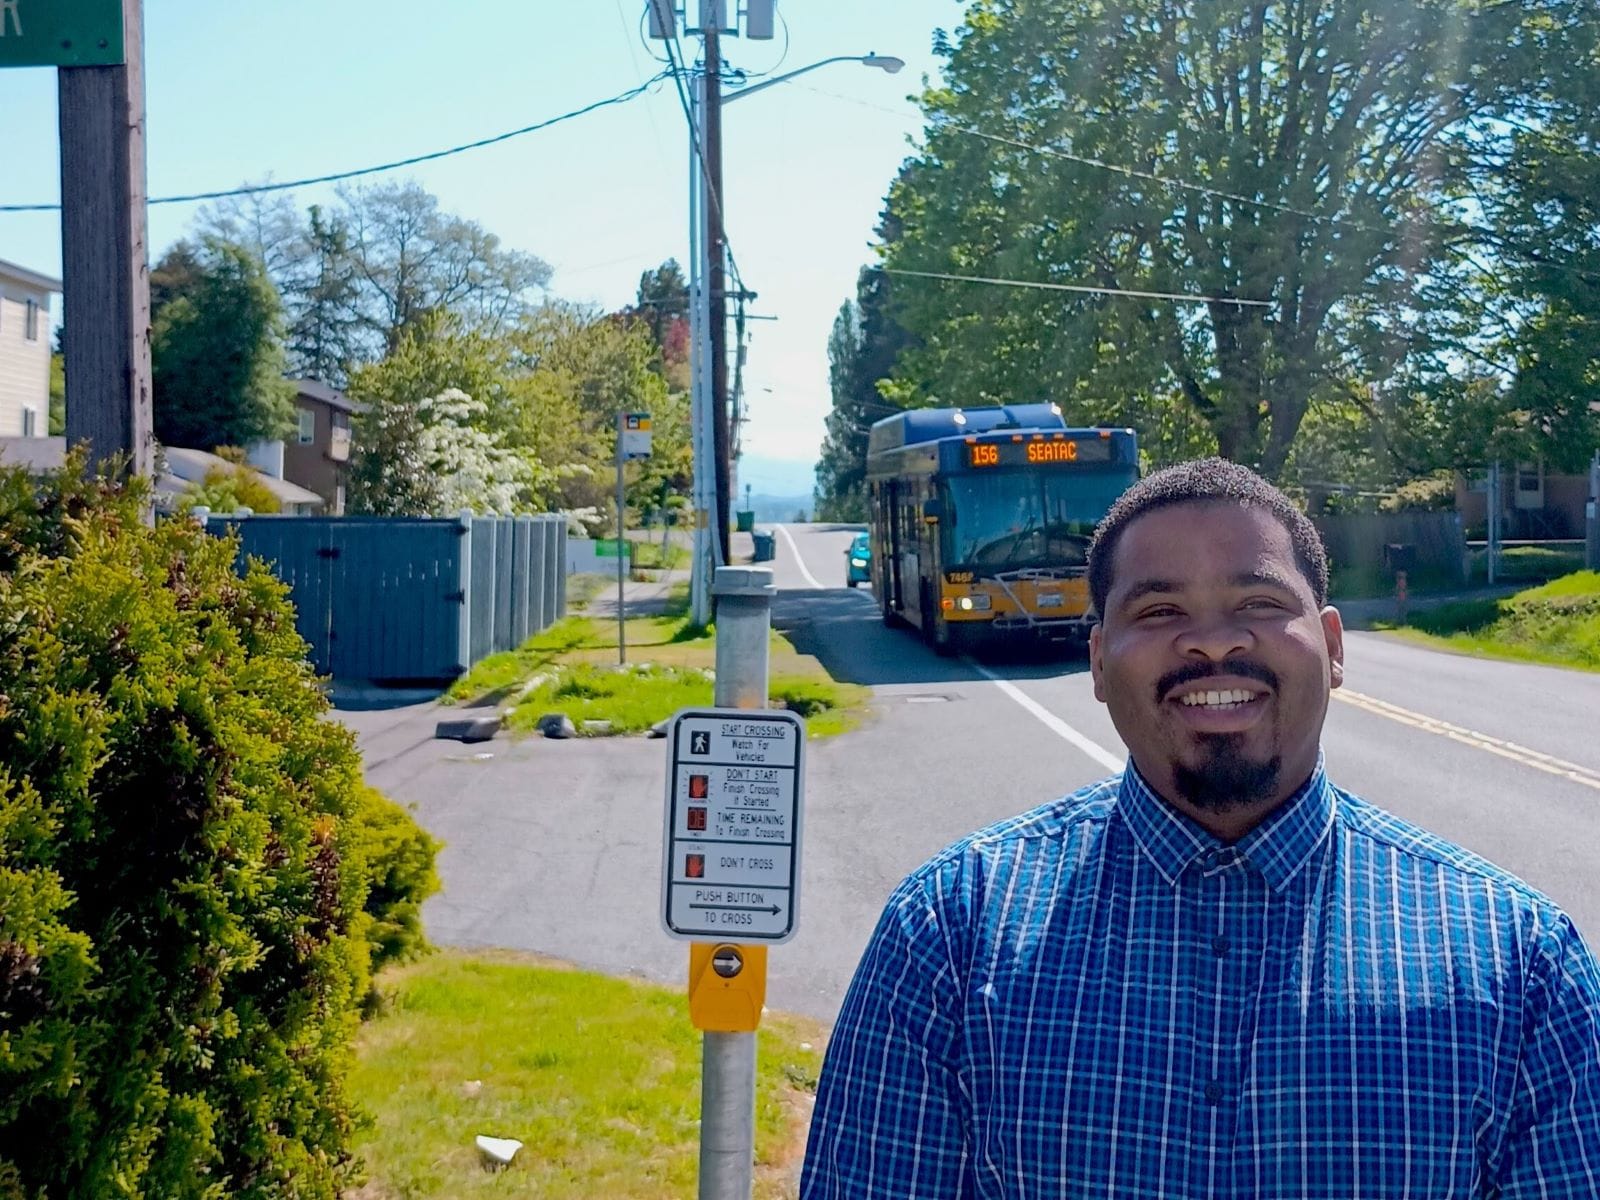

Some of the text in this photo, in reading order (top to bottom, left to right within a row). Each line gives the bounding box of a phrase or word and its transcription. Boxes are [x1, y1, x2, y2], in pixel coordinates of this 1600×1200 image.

[973, 441, 1077, 465] 156 SEATAC
[722, 724, 785, 737] START CROSSING
[732, 739, 770, 750] Watch For
[736, 753, 765, 762] Vehicles
[726, 769, 778, 780] DON'T START
[723, 782, 780, 797] Finish Crossing
[743, 796, 769, 807] Started
[717, 812, 785, 826] TIME REMAINING
[715, 825, 723, 835] To
[729, 826, 750, 837] Finish
[755, 826, 785, 839] Crossing
[720, 857, 774, 870] DON'T CROSS
[696, 890, 765, 904] PUSH BUTTON
[704, 911, 753, 925] TO CROSS
